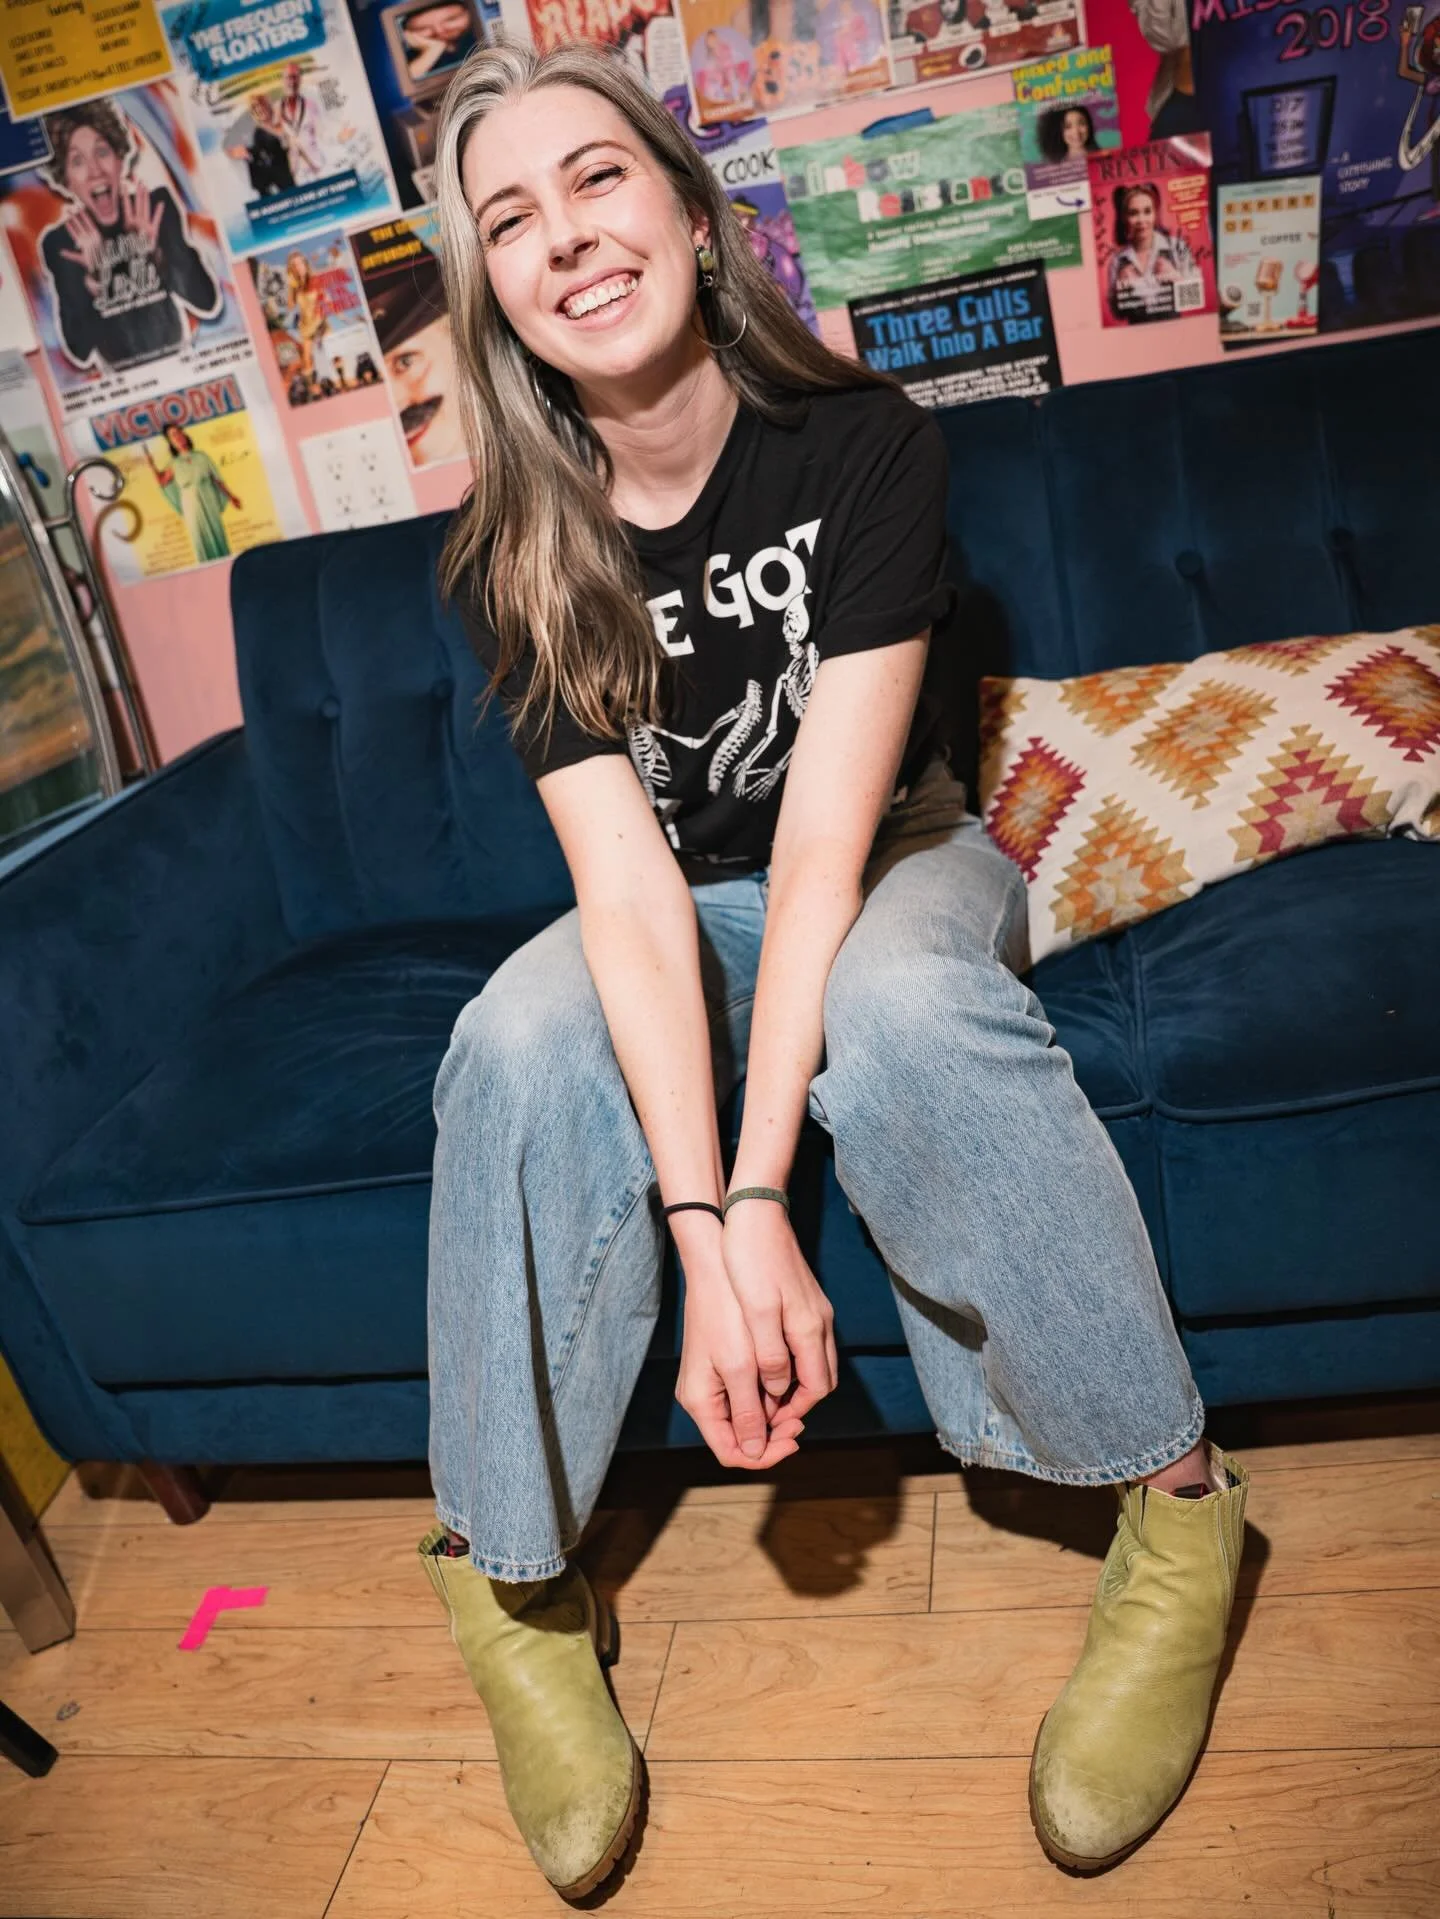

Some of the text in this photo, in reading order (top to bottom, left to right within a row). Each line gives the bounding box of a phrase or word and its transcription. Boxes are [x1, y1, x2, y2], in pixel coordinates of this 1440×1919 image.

[190, 0, 313, 52] THE FREQUENT
[208, 18, 309, 66] FLOATERS
[1275, 0, 1390, 61] 2018
[1075, 43, 1112, 70] and
[1016, 63, 1113, 104] Confused
[723, 146, 776, 184] COOK
[864, 340, 928, 373] Walk
[982, 324, 999, 349] A
[1004, 316, 1044, 345] Bar
[866, 304, 952, 346] Three
[93, 375, 243, 448] VICTORY!
[703, 518, 823, 630] GOT
